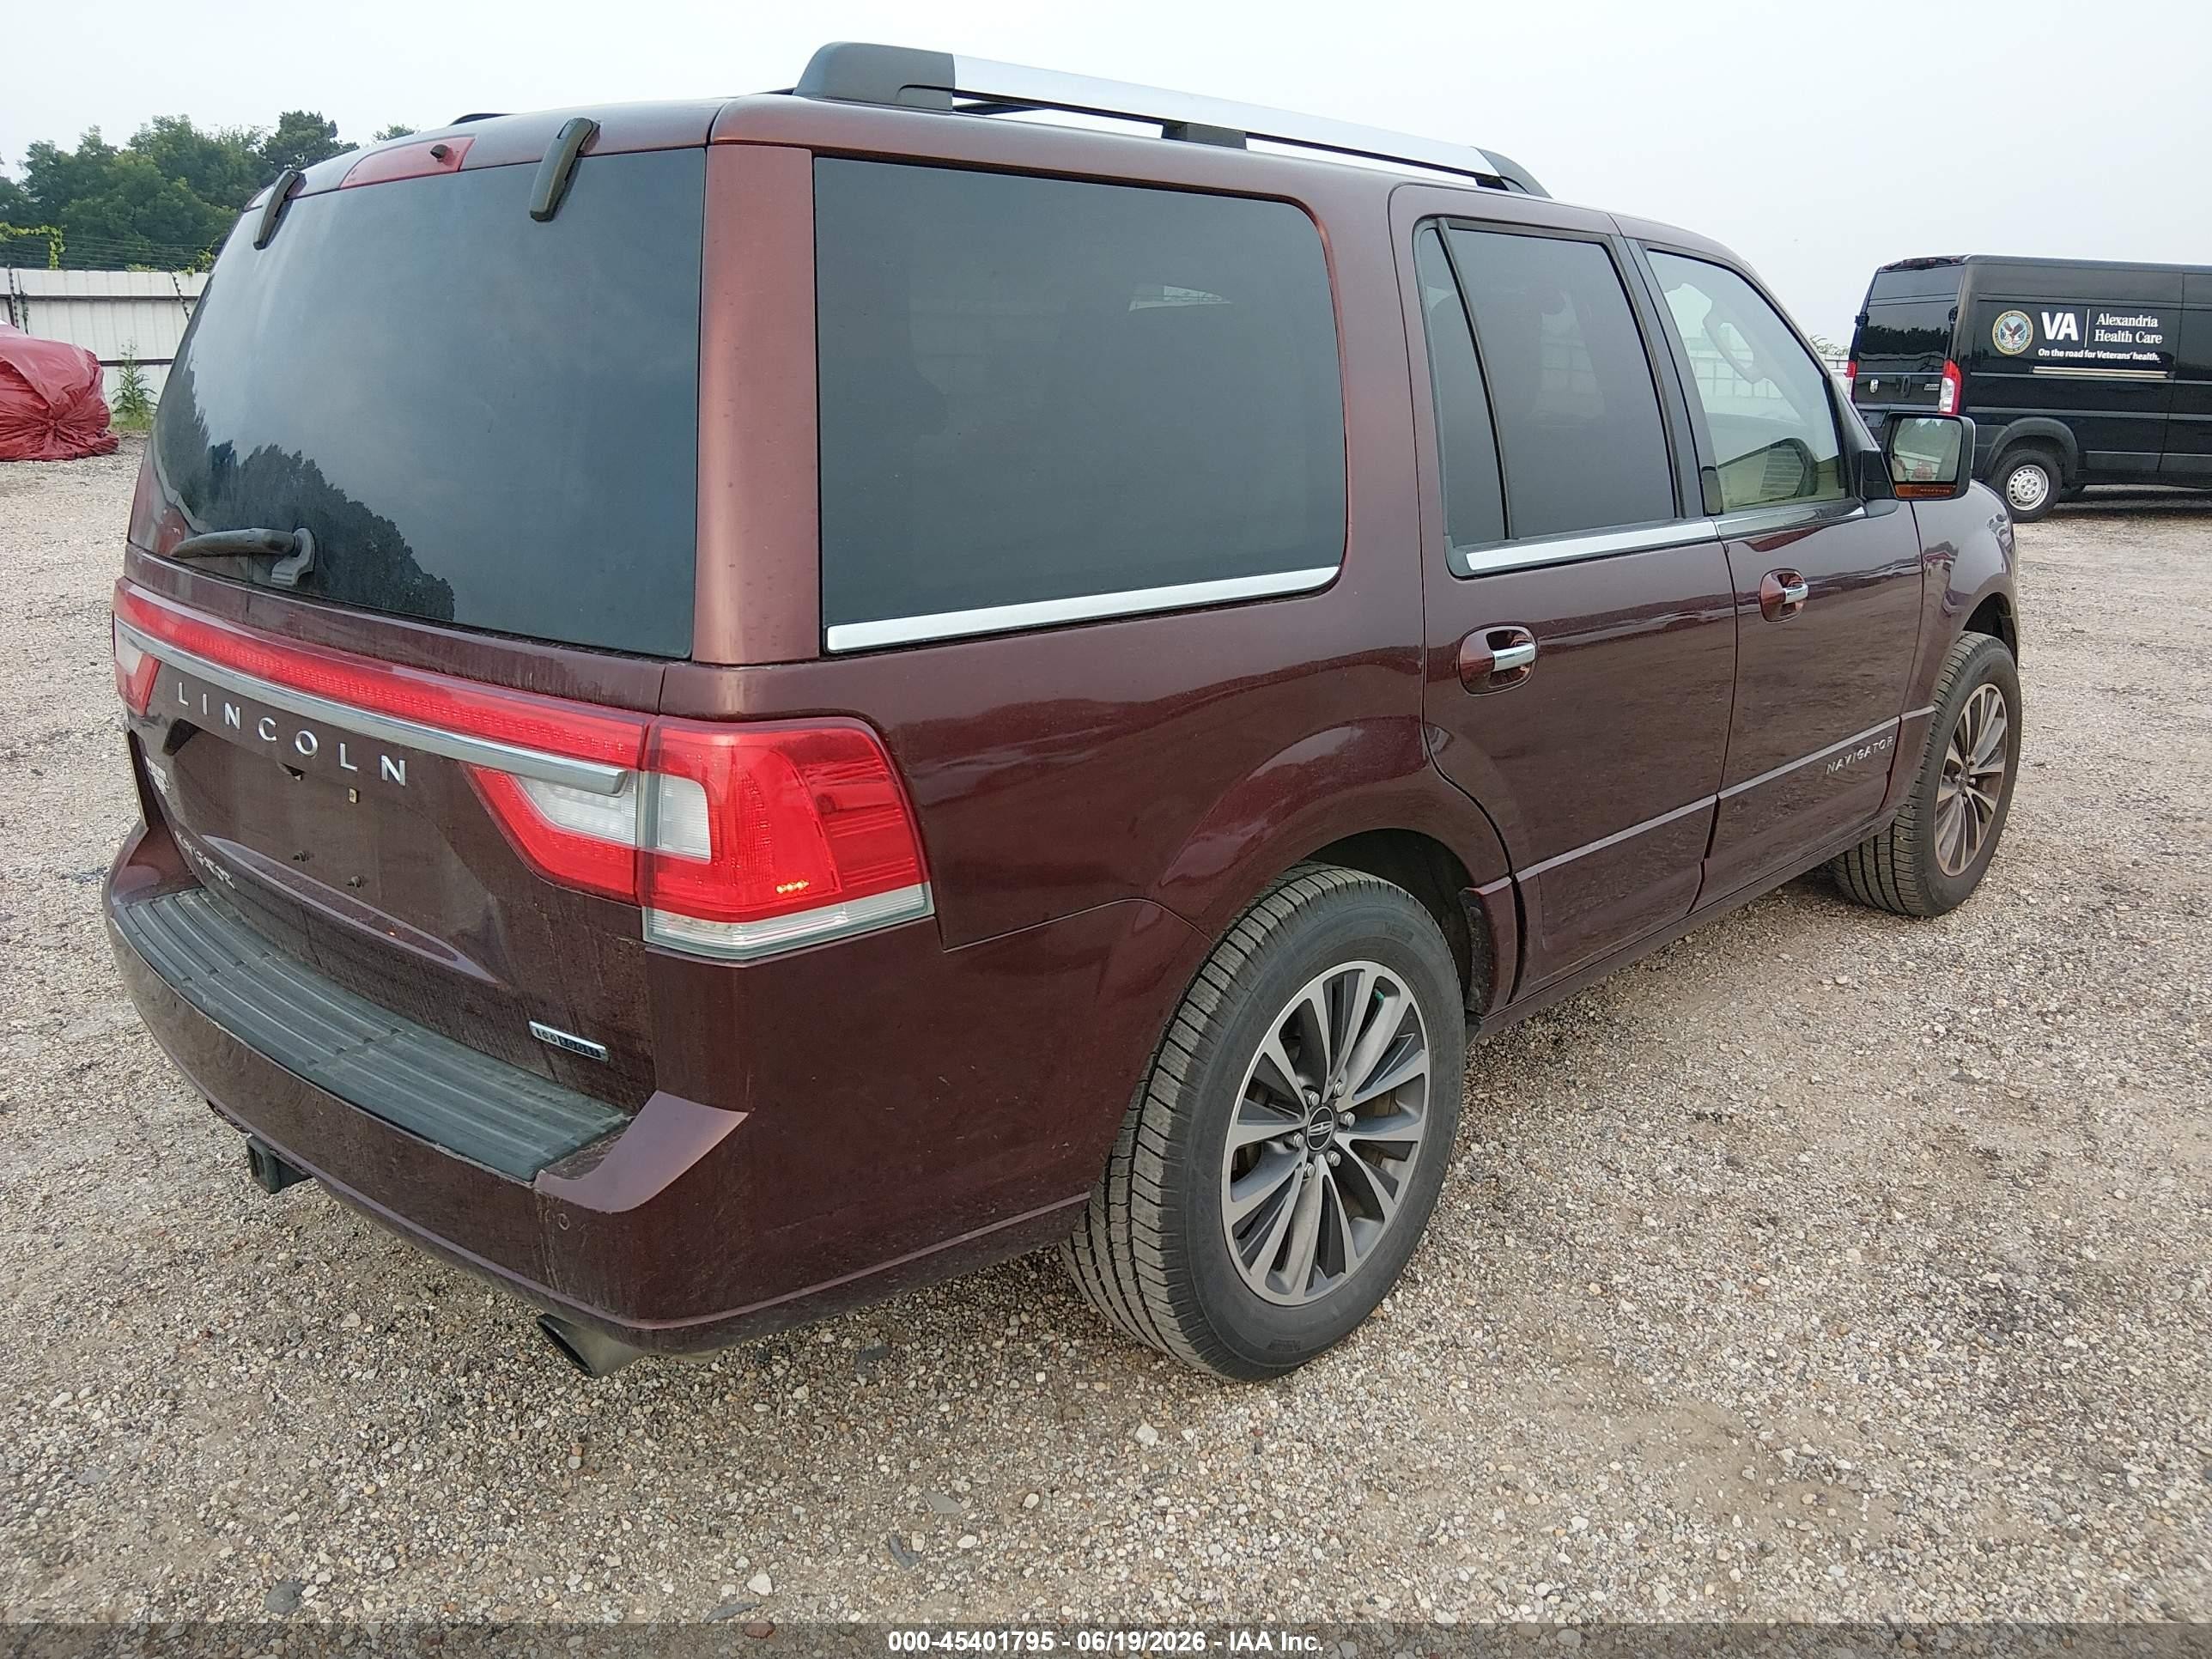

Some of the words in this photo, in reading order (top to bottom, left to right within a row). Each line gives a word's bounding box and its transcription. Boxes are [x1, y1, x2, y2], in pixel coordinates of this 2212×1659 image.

[2040, 312, 2079, 341] VA
[2095, 313, 2159, 327] Alexandria
[2094, 329, 2133, 343] Health
[2136, 331, 2163, 344] Care
[2038, 348, 2051, 357] On
[2051, 348, 2065, 357] the
[2065, 349, 2084, 358] road
[2084, 349, 2096, 359] for
[177, 681, 407, 787] LINCOLN
[1826, 736, 1894, 775] NAVIGATOR
